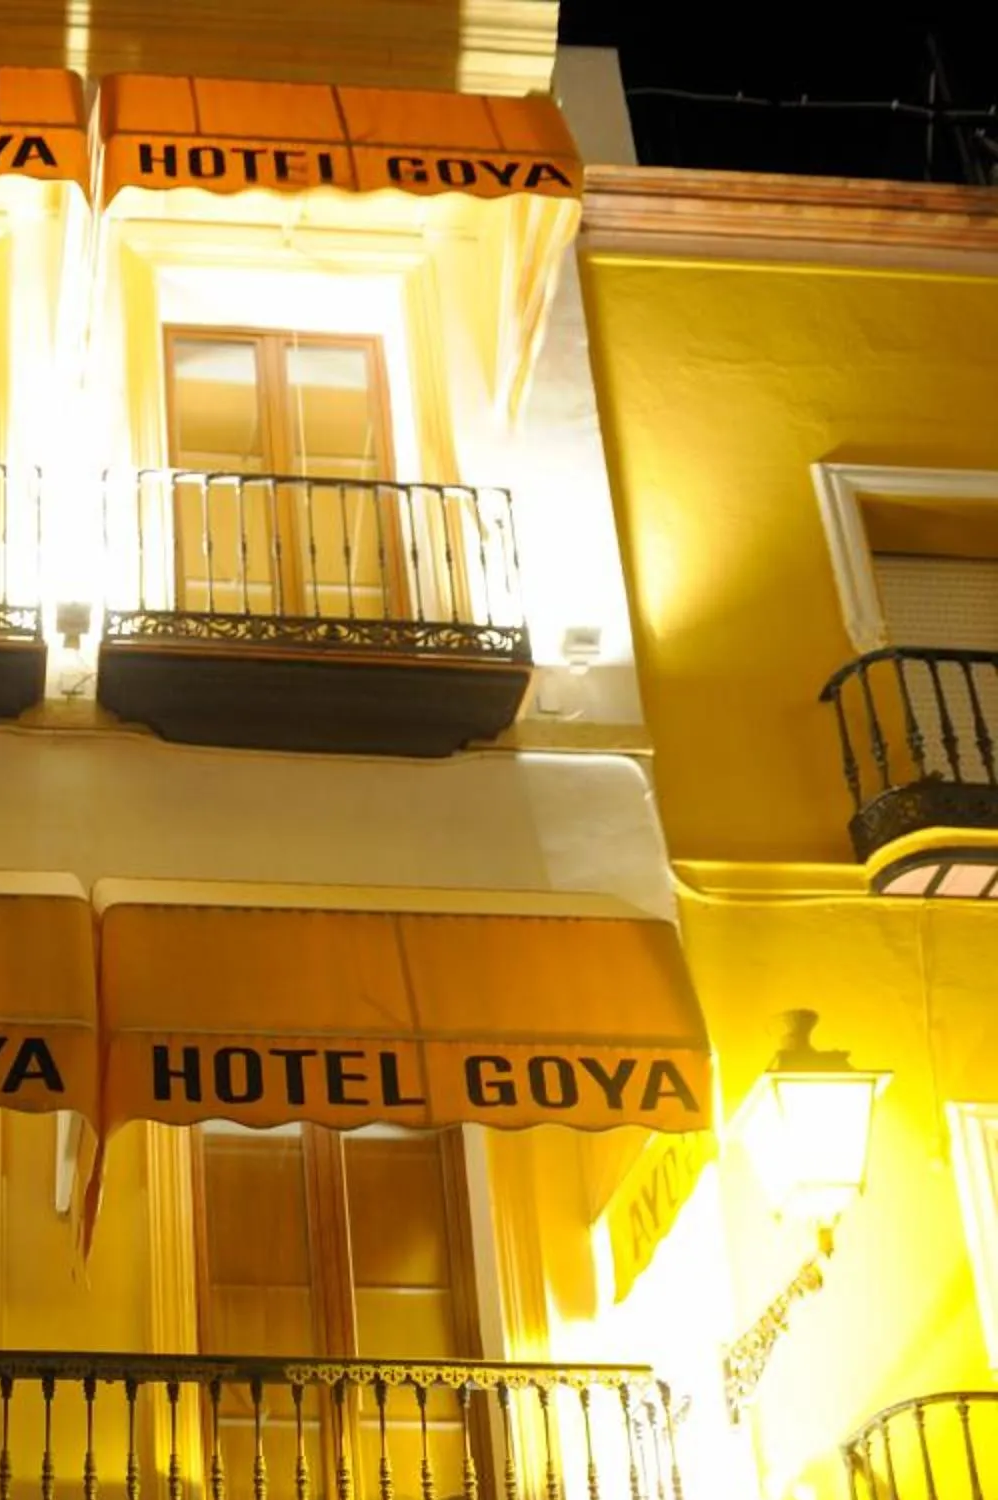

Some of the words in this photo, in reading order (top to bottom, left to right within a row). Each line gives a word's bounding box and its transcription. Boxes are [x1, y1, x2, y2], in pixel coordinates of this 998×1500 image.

[138, 143, 343, 185] HOTEL
[386, 155, 572, 189] GOYA
[153, 1044, 427, 1108] HOTEL
[464, 1054, 700, 1112] GOYA
